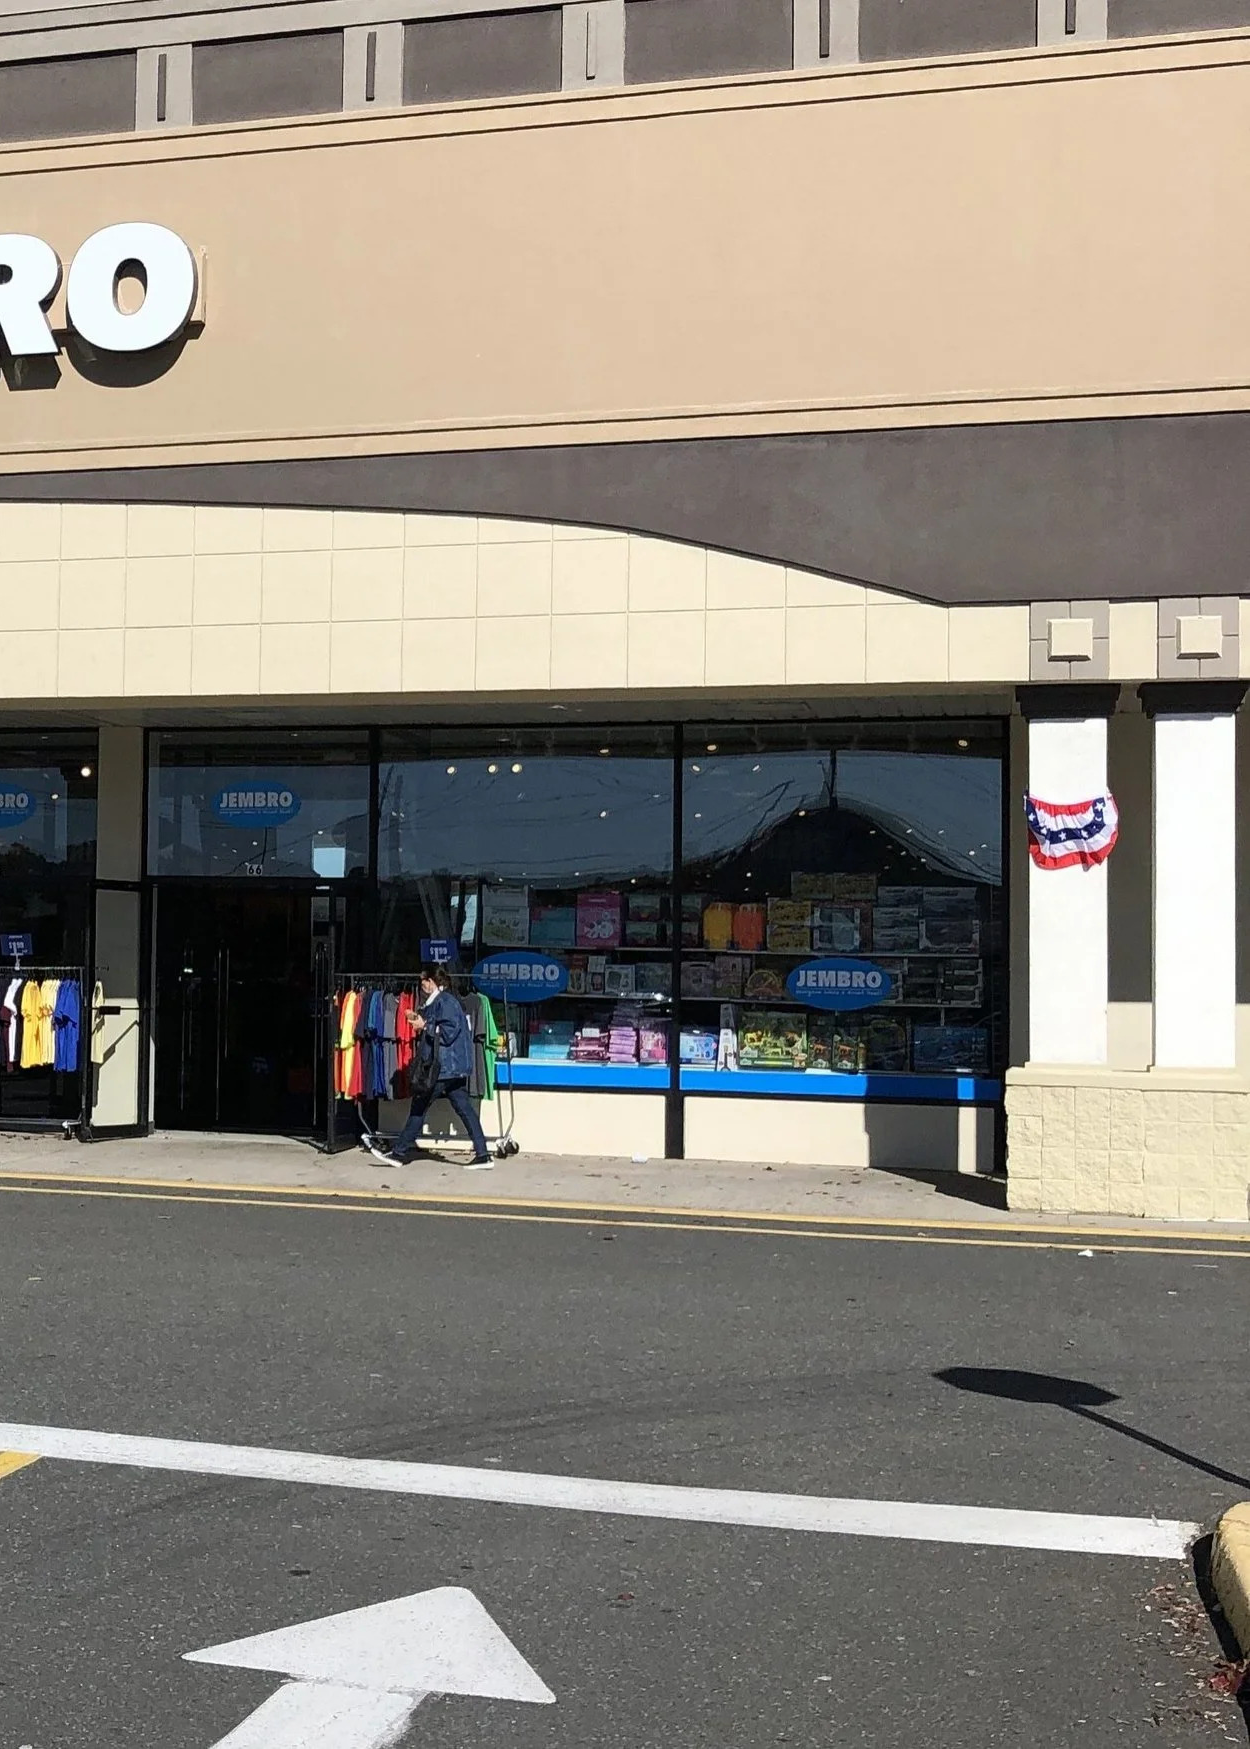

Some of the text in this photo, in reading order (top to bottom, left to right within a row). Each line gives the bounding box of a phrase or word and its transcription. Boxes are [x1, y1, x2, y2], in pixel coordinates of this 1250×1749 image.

[219, 791, 293, 808] JEMBRO
[248, 865, 262, 875] 66
[480, 963, 559, 980] JEMBRO
[796, 970, 882, 988] JEMBRO
